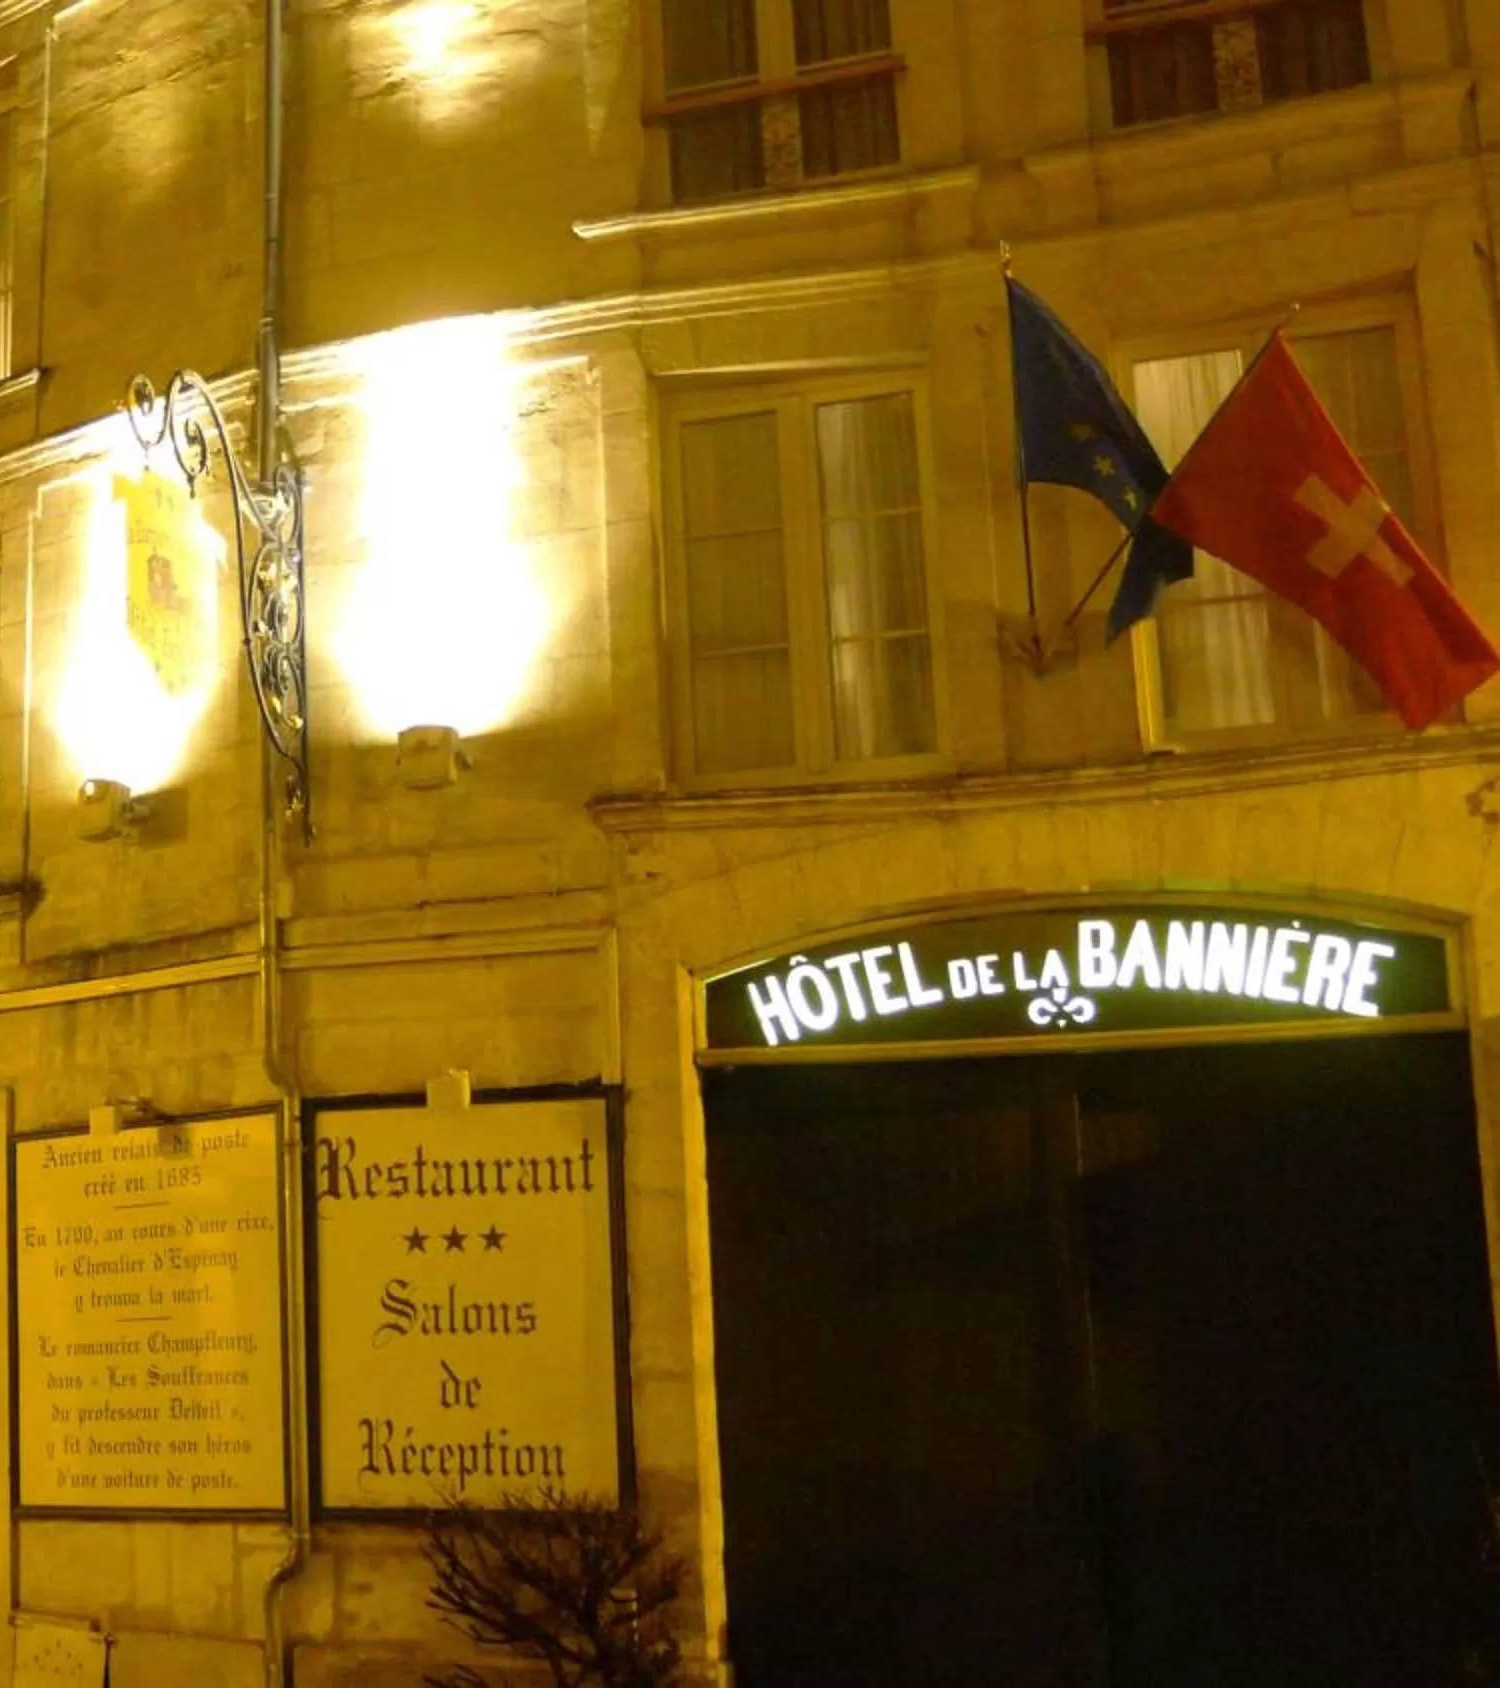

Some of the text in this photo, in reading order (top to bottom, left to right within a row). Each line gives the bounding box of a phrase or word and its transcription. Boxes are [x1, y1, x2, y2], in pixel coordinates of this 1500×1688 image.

[747, 919, 1395, 1046] HÔTEL DE LA BANNIÈRE
[42, 1144, 103, 1169] Ancien
[202, 1130, 249, 1158] poste
[317, 1136, 595, 1202] Restaurant
[125, 1176, 145, 1193] en
[157, 1167, 202, 1190] 1685
[24, 1227, 47, 1249] En
[149, 1287, 163, 1305] la
[373, 1278, 538, 1346] Salons
[47, 1372, 84, 1391] dans
[440, 1360, 482, 1410] de
[358, 1417, 566, 1492] Réception
[166, 1469, 184, 1489] de
